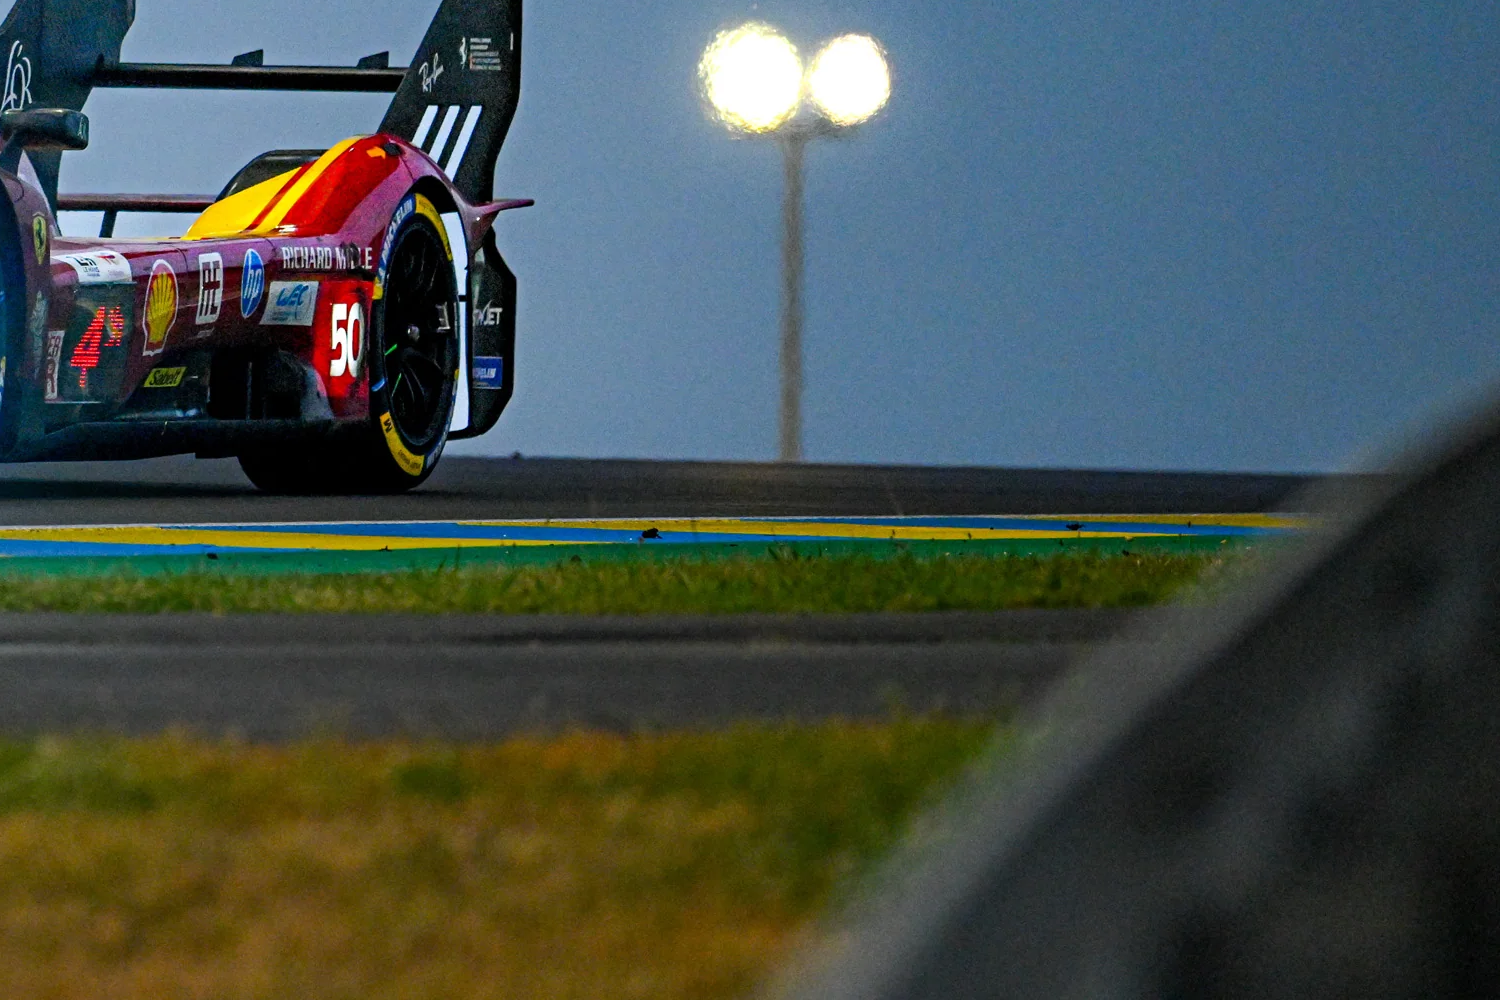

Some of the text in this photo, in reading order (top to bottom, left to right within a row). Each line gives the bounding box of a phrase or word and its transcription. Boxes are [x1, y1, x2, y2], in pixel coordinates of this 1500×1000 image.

[243, 250, 262, 316] hp
[281, 246, 333, 270] RICHARD
[329, 302, 365, 378] 50
